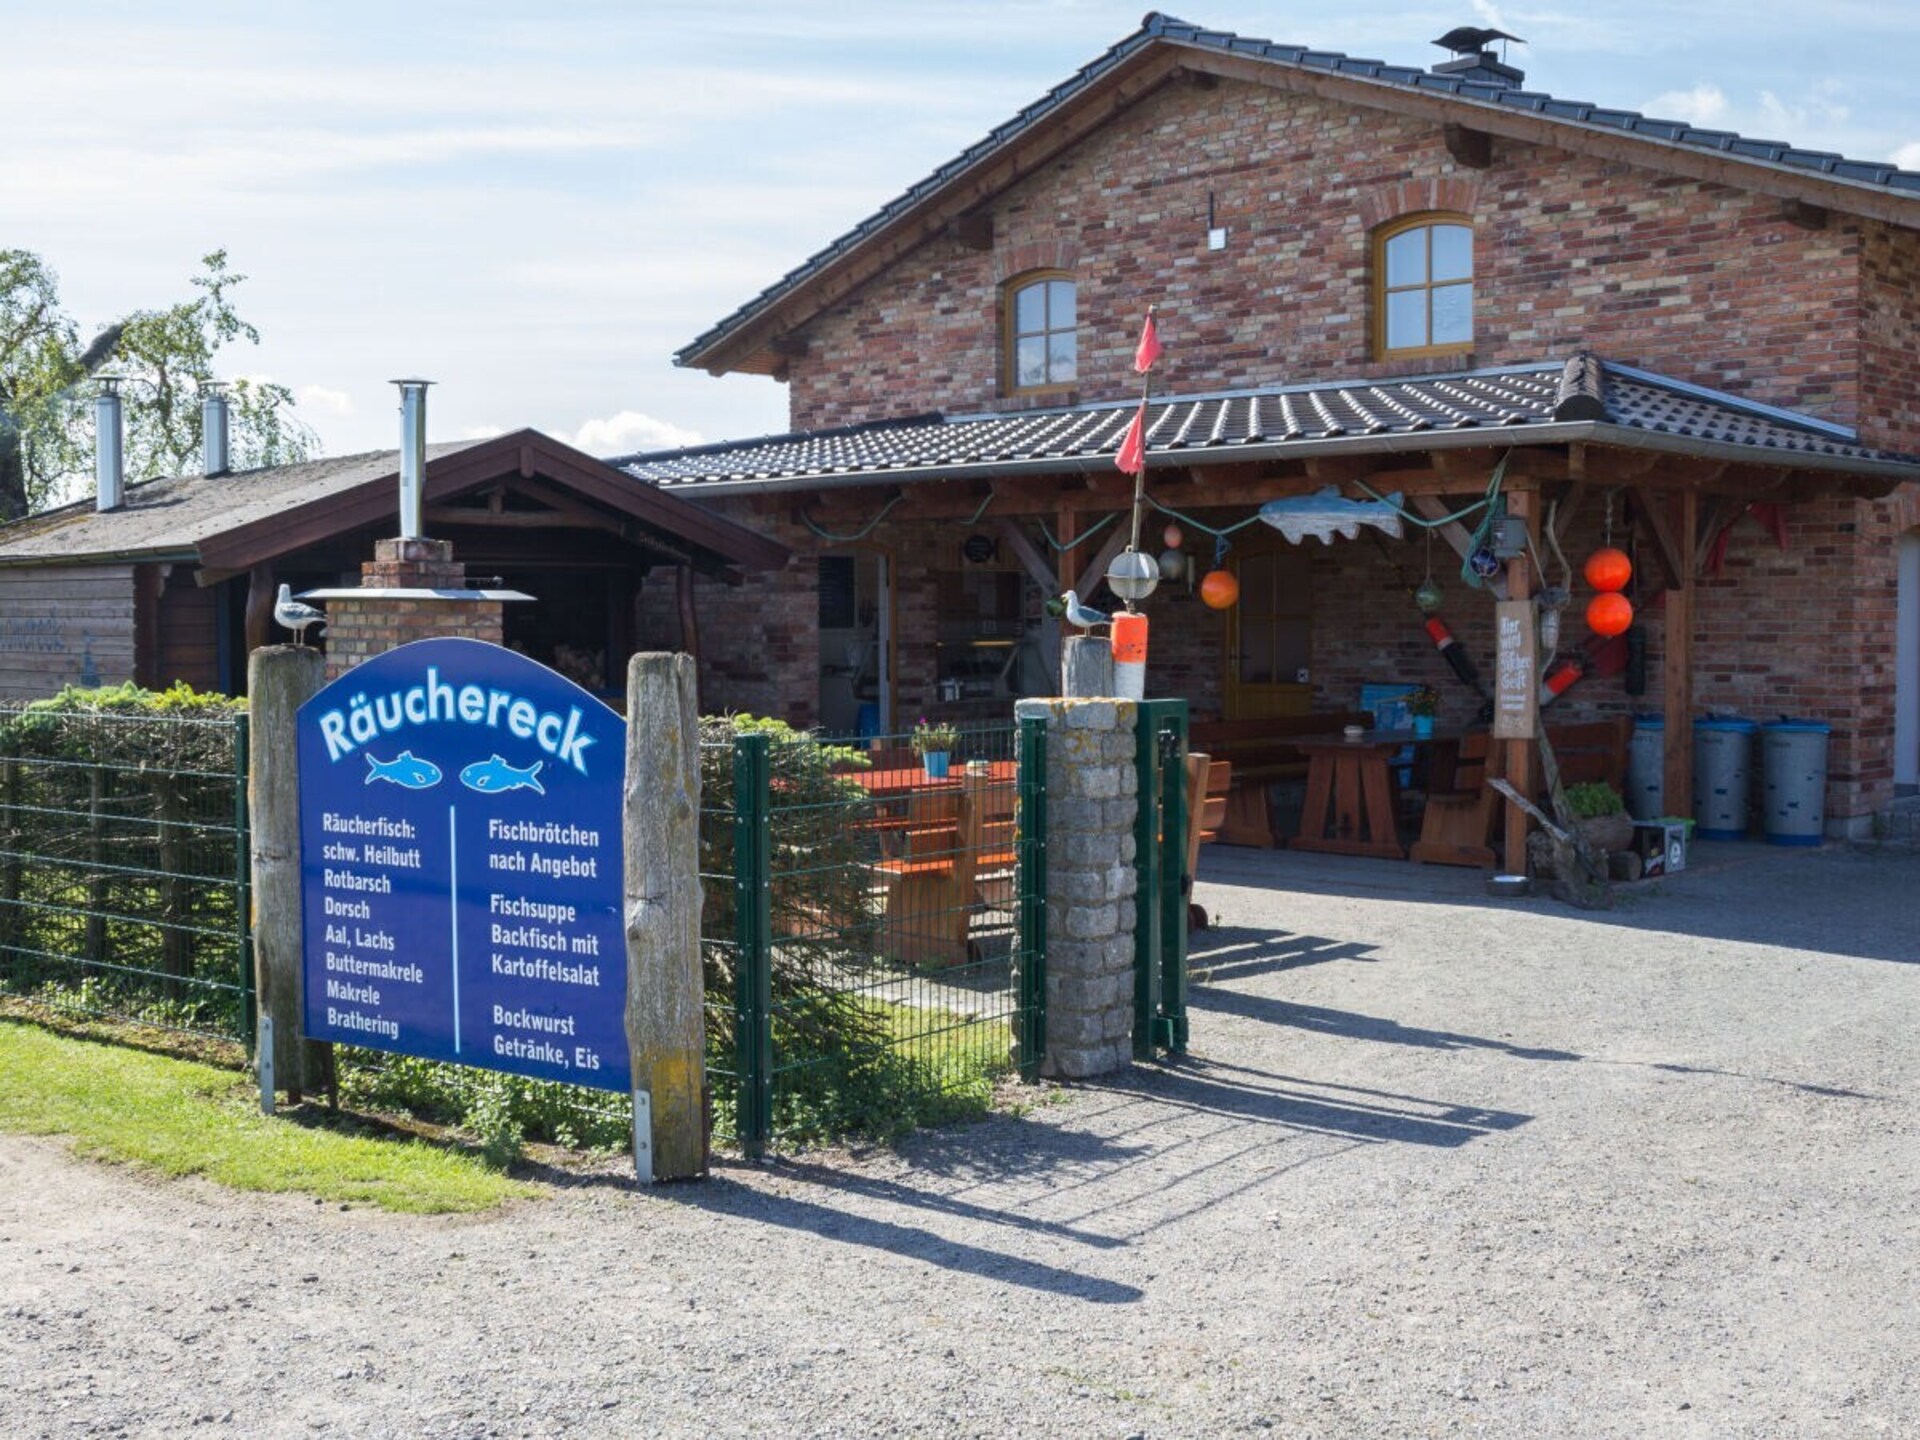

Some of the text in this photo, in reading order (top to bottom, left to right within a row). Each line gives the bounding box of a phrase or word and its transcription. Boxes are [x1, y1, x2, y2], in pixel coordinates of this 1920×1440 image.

[319, 666, 598, 776] Räuchereck
[323, 813, 415, 838] Räucherfisch:
[490, 819, 598, 846] Fischbrötchen
[324, 843, 420, 868] schw. Heilbutt
[490, 851, 596, 878] nach Angebot
[325, 869, 390, 893] Rotbarsch
[325, 896, 370, 919] Dorsch
[491, 894, 575, 925] Fischsuppe
[325, 924, 394, 951] Aal, Lachs
[492, 924, 598, 955] Backfisch mit
[326, 952, 422, 984] Buttermakrele
[492, 954, 599, 986] Kartoffelsalat
[327, 979, 380, 1005] Makrele
[328, 1007, 398, 1039] Brathering
[494, 1005, 574, 1038] Bockwurst
[494, 1034, 599, 1069] Getränke, Eis
